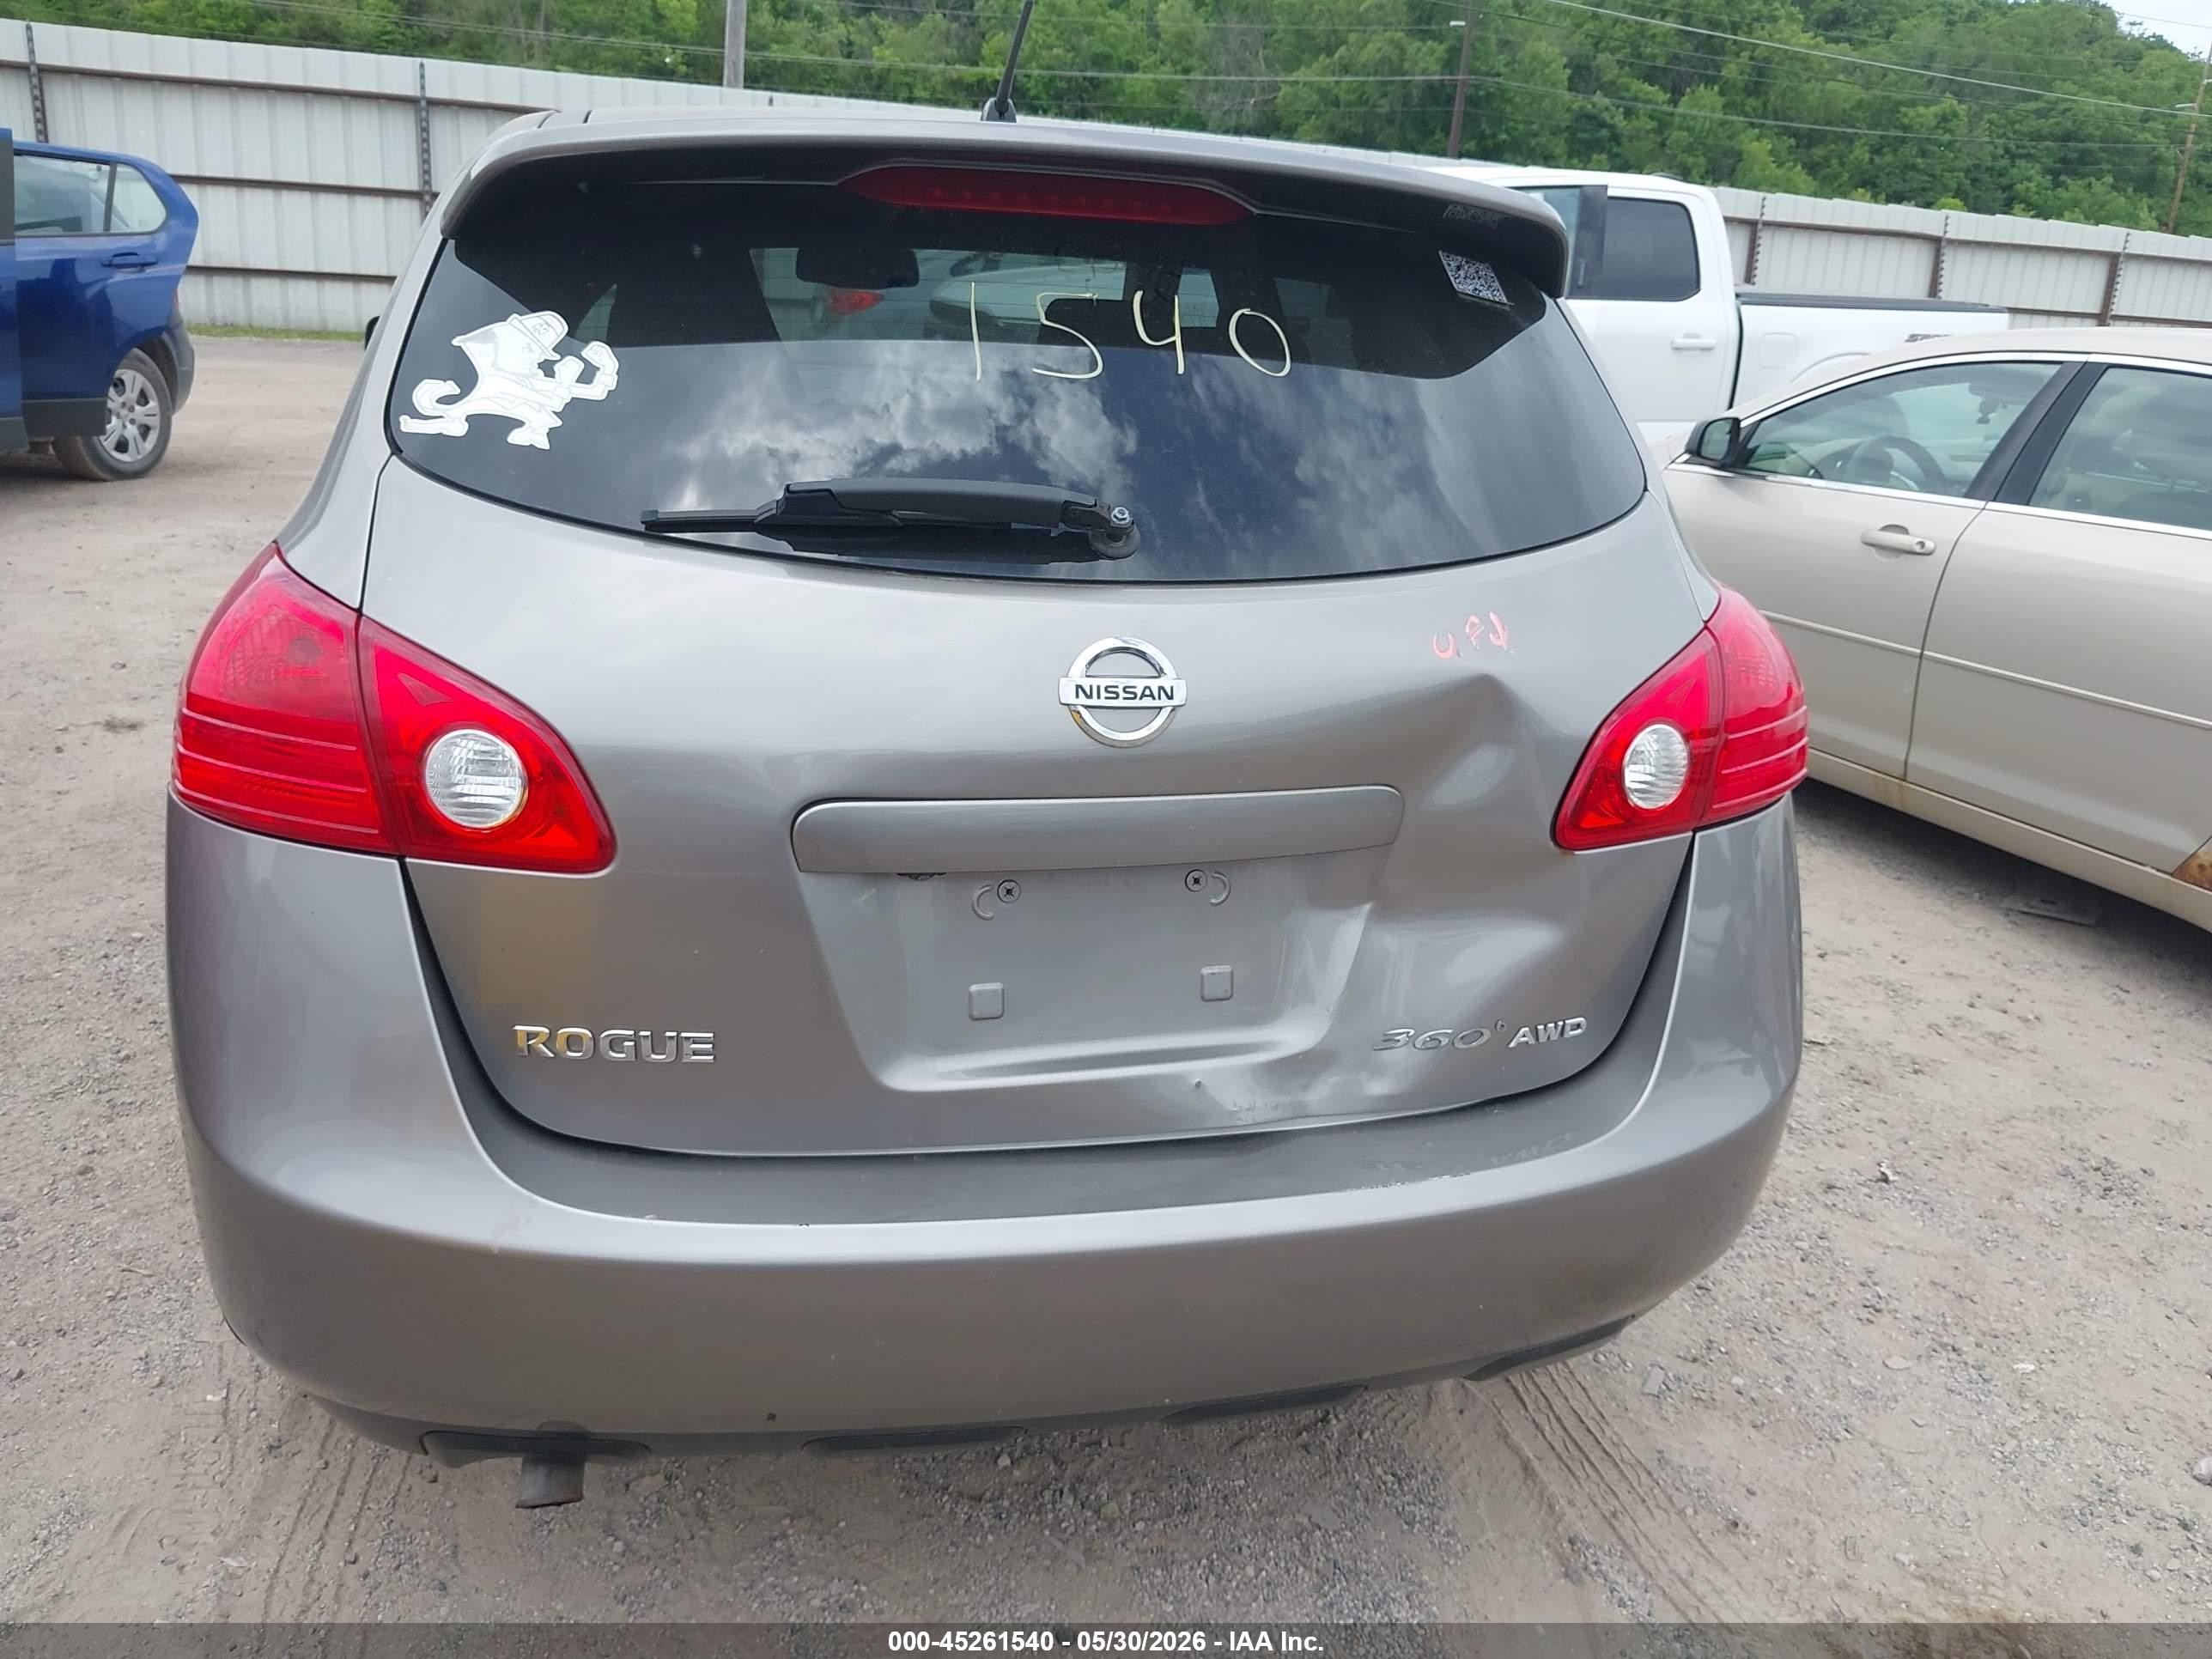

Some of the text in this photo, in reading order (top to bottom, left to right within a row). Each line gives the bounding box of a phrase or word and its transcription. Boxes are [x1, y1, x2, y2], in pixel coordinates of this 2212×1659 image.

[971, 281, 1291, 382] 1540
[1075, 684, 1175, 701] NISSAN
[513, 1024, 715, 1063] ROGUE
[1508, 1017, 1587, 1048] AWD
